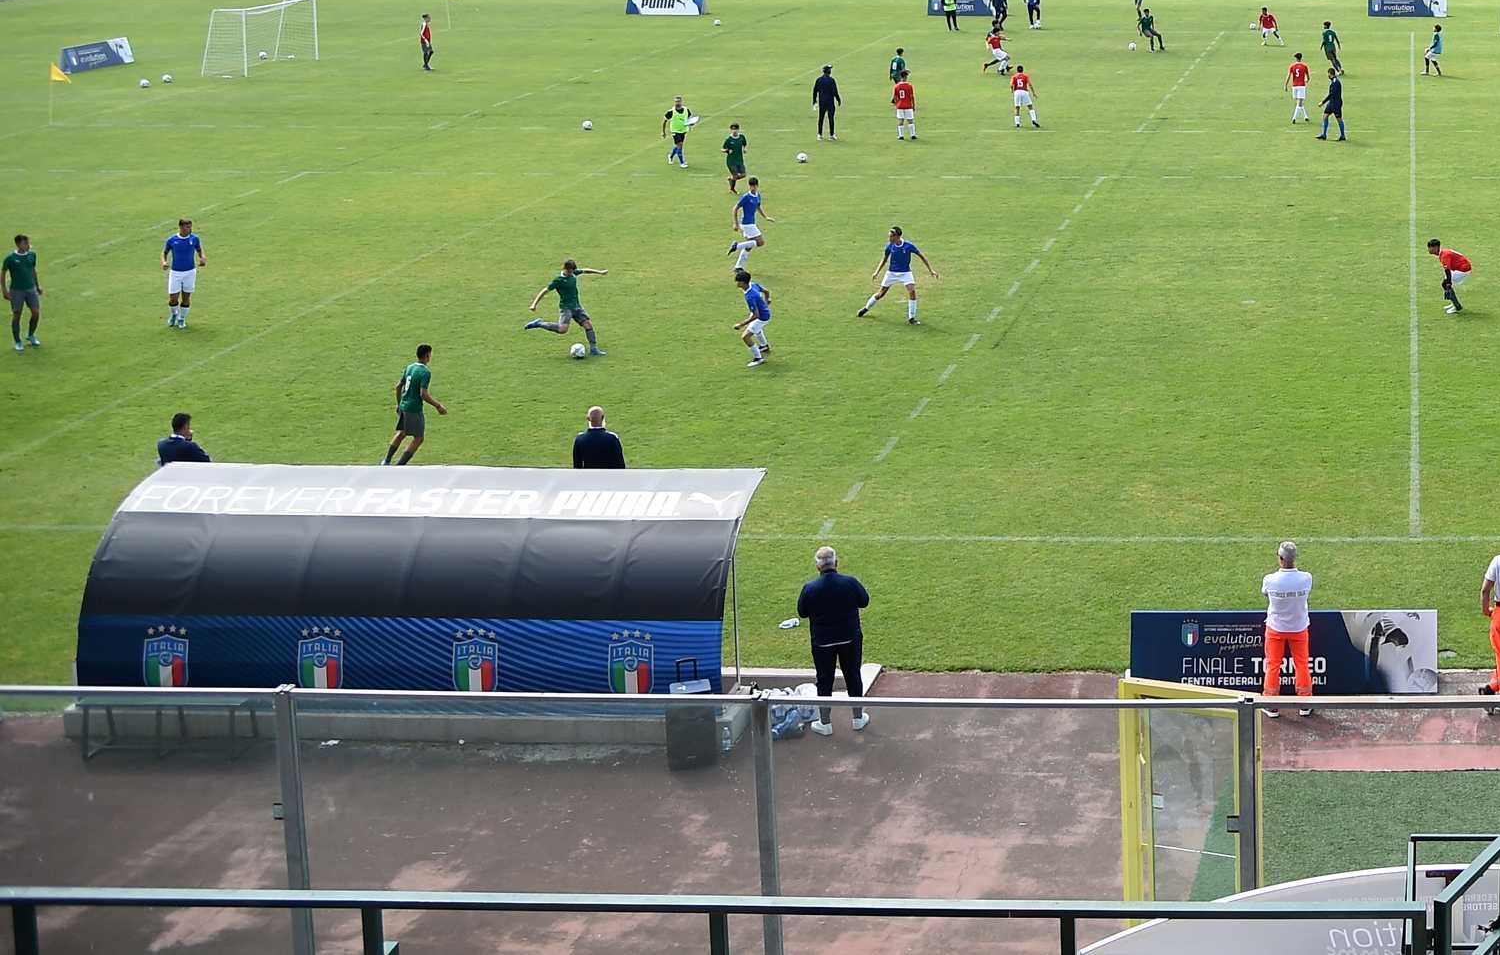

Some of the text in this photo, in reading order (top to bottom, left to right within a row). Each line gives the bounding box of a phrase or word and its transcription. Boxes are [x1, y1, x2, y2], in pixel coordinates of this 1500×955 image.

[1383, 4, 1415, 13] evolution
[131, 484, 355, 513] FOREVER
[1203, 632, 1262, 644] evolution
[148, 642, 184, 652] ITALIA
[302, 643, 339, 654] ITALIA
[457, 646, 493, 657] ITALIA
[612, 647, 649, 658] ITALIA
[1181, 657, 1245, 675] FINALE
[1181, 676, 1215, 686] CENTRI
[1217, 676, 1263, 686] FEDERALI
